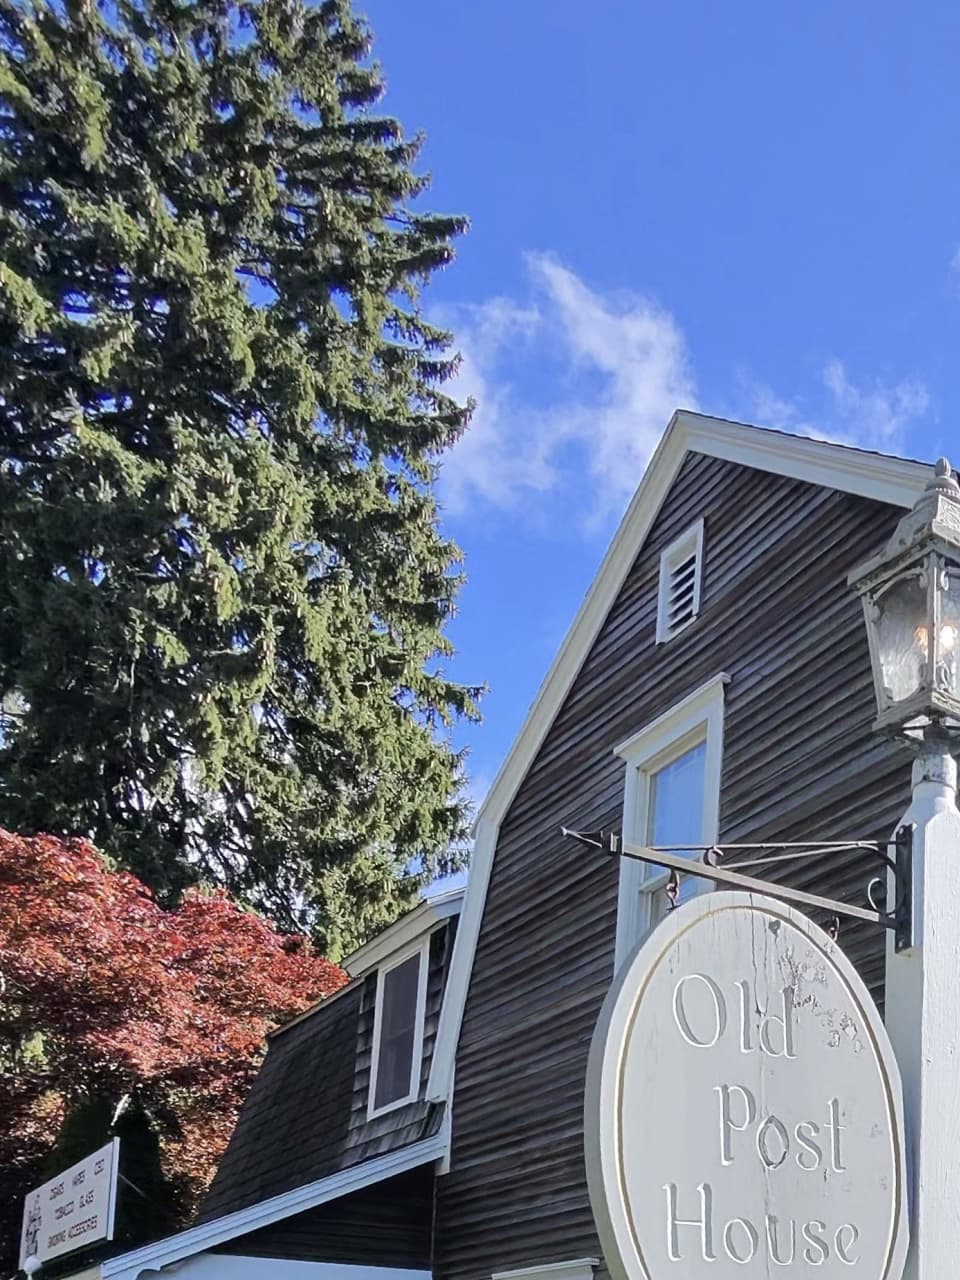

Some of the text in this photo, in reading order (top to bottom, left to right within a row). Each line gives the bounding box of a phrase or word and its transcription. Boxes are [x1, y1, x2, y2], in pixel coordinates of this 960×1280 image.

[673, 973, 798, 1059] Old
[712, 1084, 847, 1173] Post
[662, 1183, 861, 1266] House
